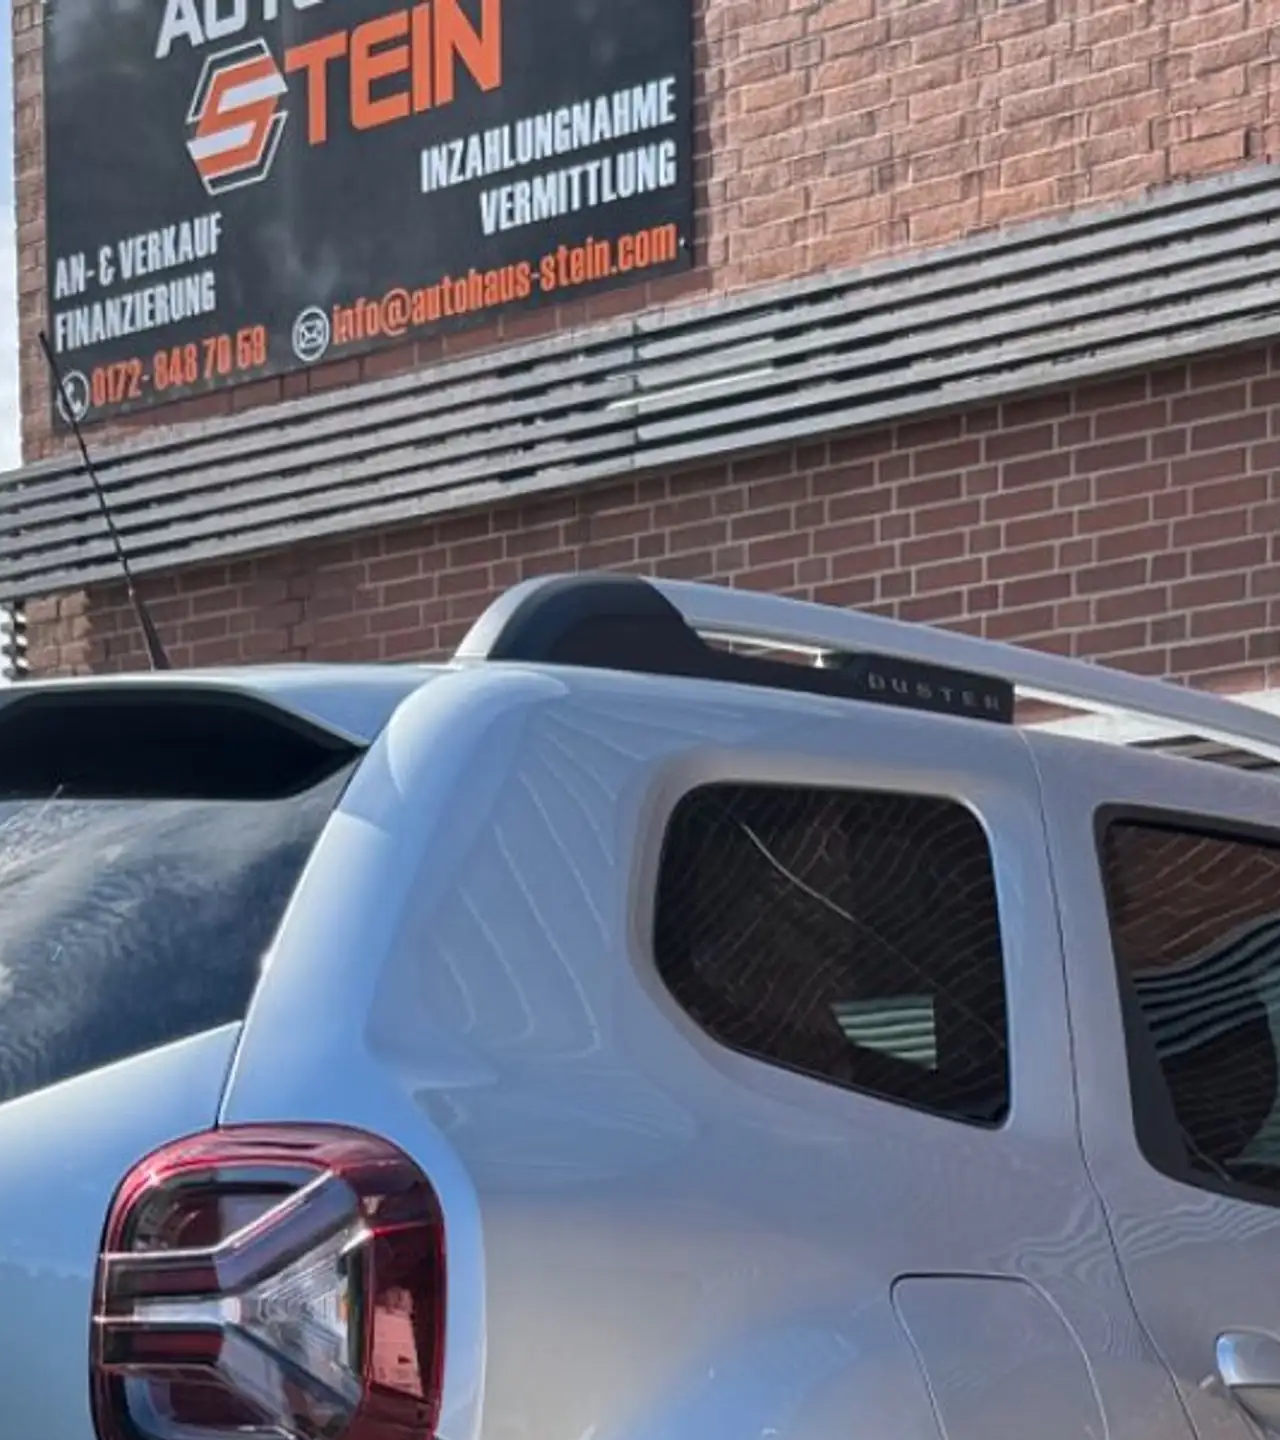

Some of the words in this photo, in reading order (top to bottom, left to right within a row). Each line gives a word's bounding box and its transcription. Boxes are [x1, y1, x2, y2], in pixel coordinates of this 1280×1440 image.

[420, 76, 677, 194] INZAHLUNGNAHME
[479, 140, 677, 236] VERMITTLUNG
[54, 251, 95, 300] AN-
[98, 244, 116, 287] &
[118, 211, 223, 280] VERKAUF
[332, 222, 677, 346] info@autohaus-stein.com
[53, 269, 217, 354] FINANZIERUNG
[152, 342, 198, 391] 848
[201, 333, 232, 381] 70
[867, 670, 1001, 712] DUSTER
